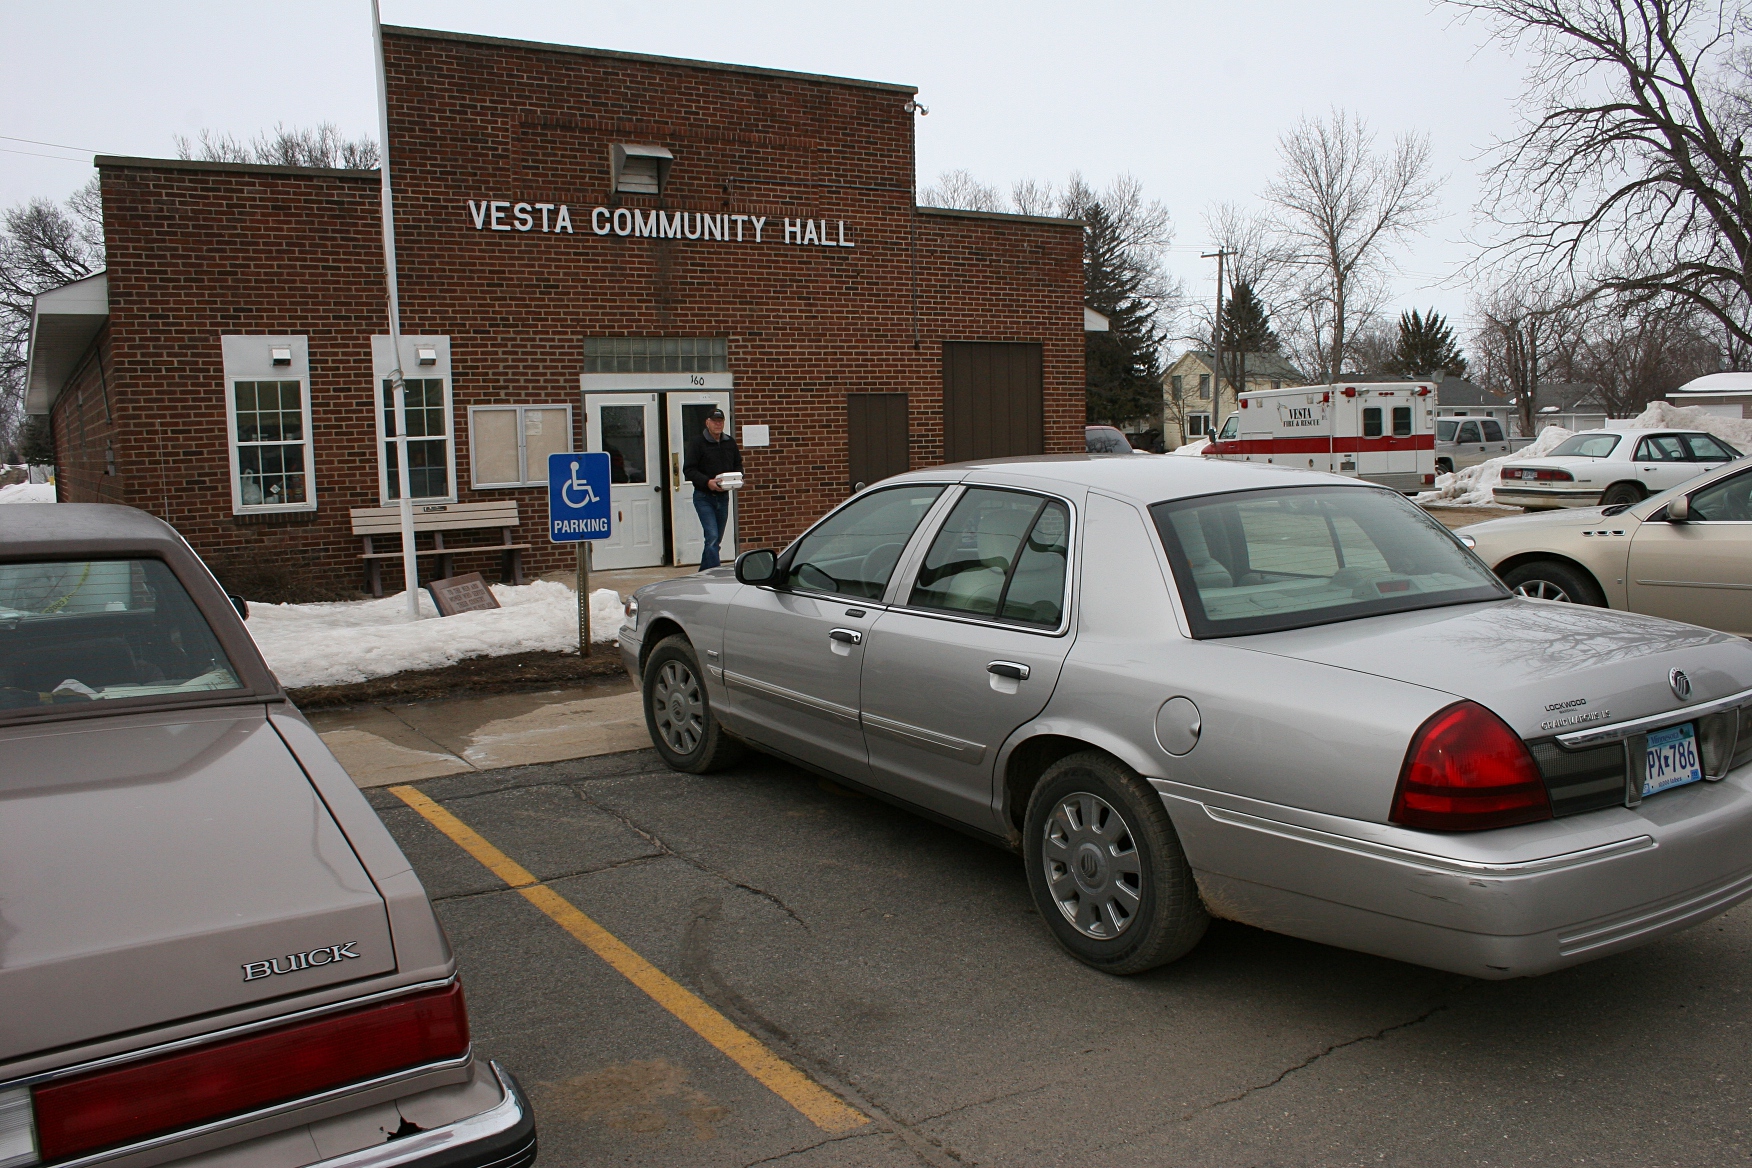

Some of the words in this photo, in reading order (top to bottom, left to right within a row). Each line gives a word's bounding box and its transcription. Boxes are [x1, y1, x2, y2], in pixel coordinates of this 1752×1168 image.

[468, 200, 574, 234] VESTA
[591, 206, 766, 243] COMMUNITY
[784, 217, 856, 248] HALL
[690, 374, 705, 386] 160
[1289, 407, 1312, 419] VESTA
[1301, 419, 1320, 427] RESCUE
[554, 517, 608, 534] PARKING
[1544, 698, 1587, 712] LOCKWOOD
[1541, 718, 1568, 730] GRAND
[1650, 731, 1679, 745] Minnesota
[241, 940, 360, 982] BUICK
